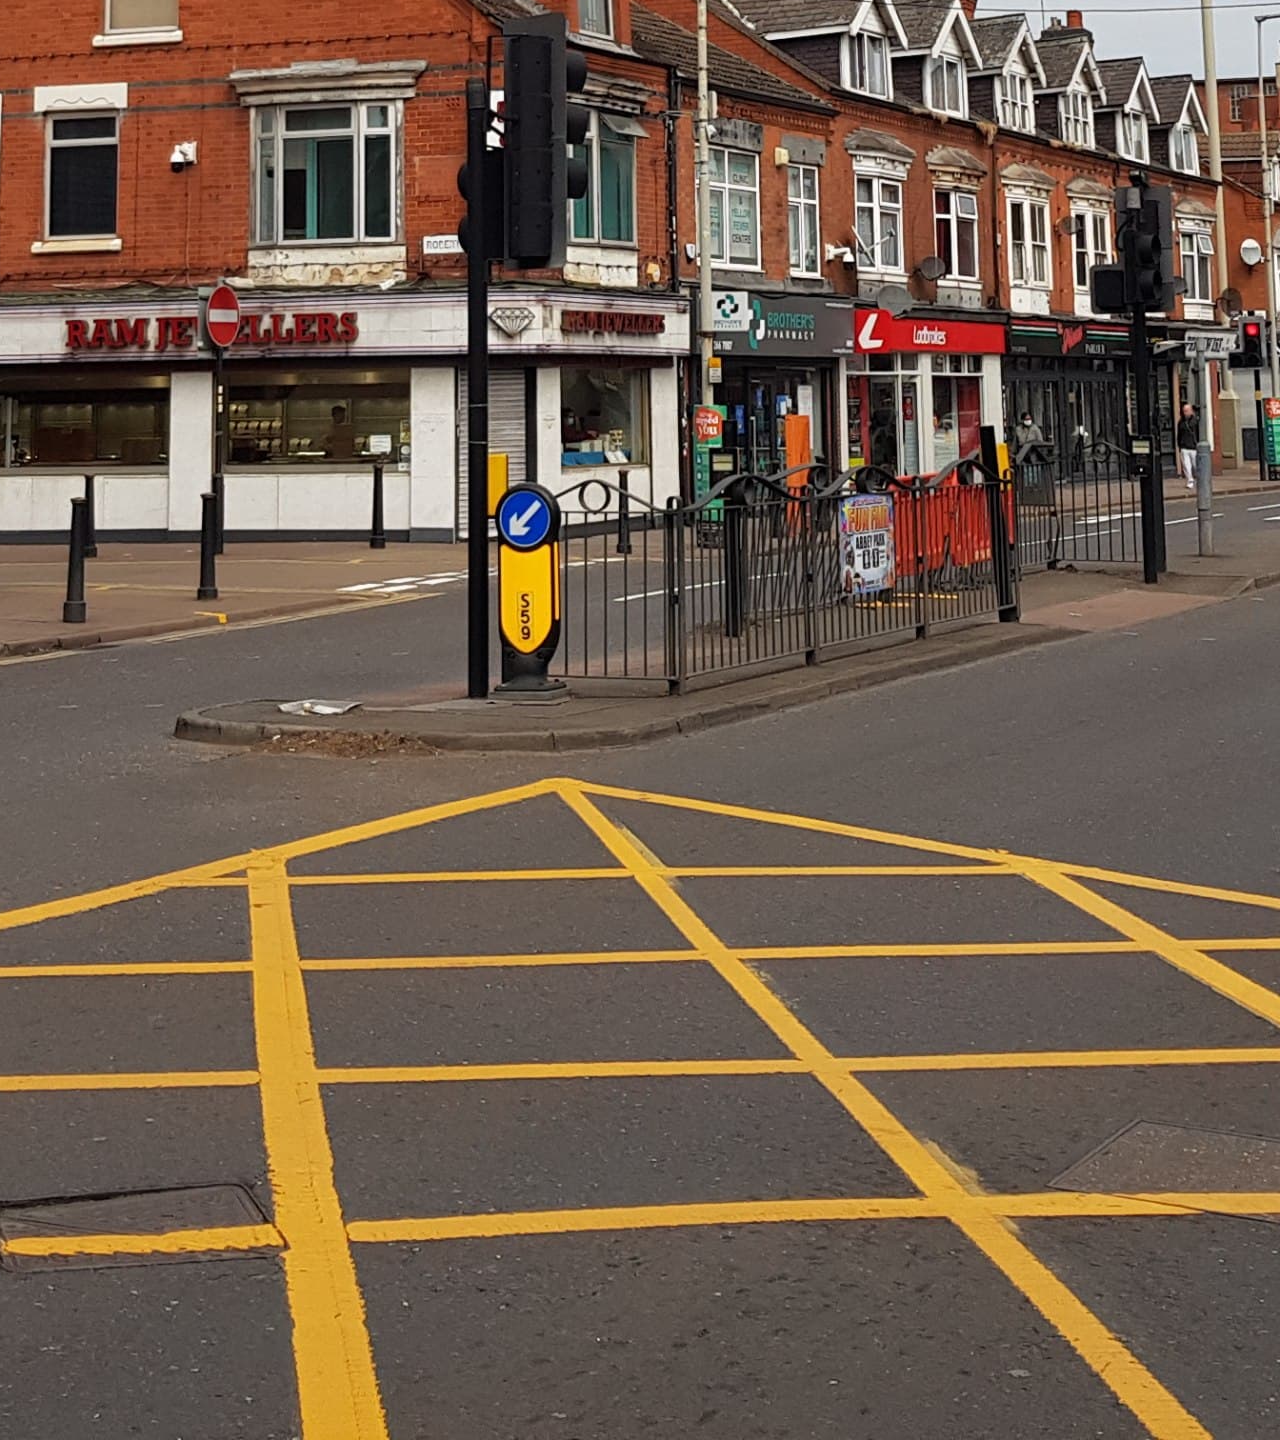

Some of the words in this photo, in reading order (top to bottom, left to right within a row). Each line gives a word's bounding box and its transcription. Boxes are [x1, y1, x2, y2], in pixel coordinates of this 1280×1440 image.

[767, 312, 815, 329] BROTHER'S
[65, 317, 150, 349] RAM
[155, 312, 359, 352] JEELLERS
[767, 330, 815, 340] PHARMACY
[913, 325, 947, 345] Ladbrokes
